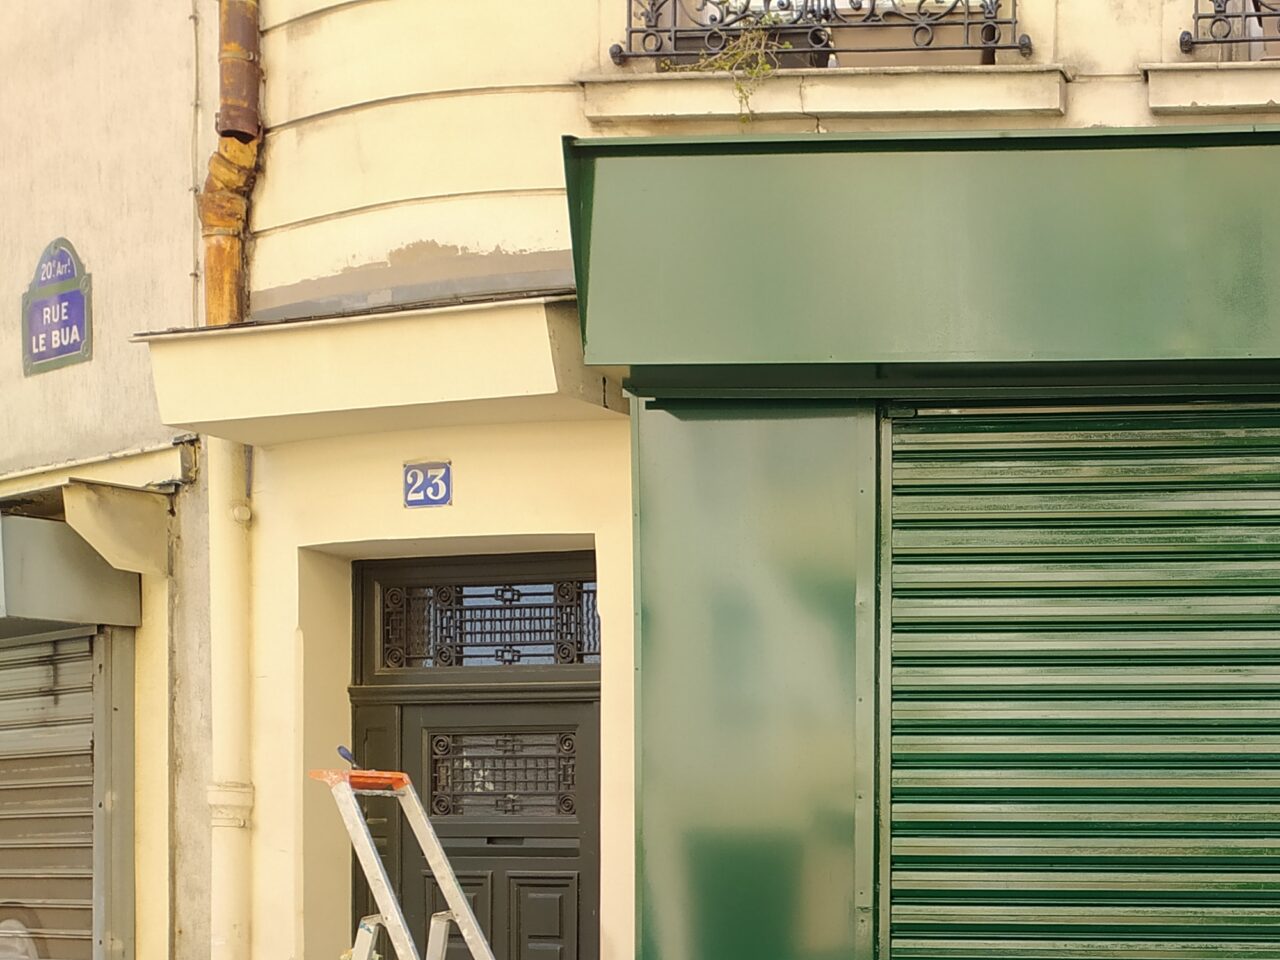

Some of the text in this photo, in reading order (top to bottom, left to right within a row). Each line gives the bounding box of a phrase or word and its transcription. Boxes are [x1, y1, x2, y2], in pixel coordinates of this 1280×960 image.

[43, 302, 69, 325] RUE
[32, 325, 80, 353] LE BUA
[407, 468, 446, 501] 23
